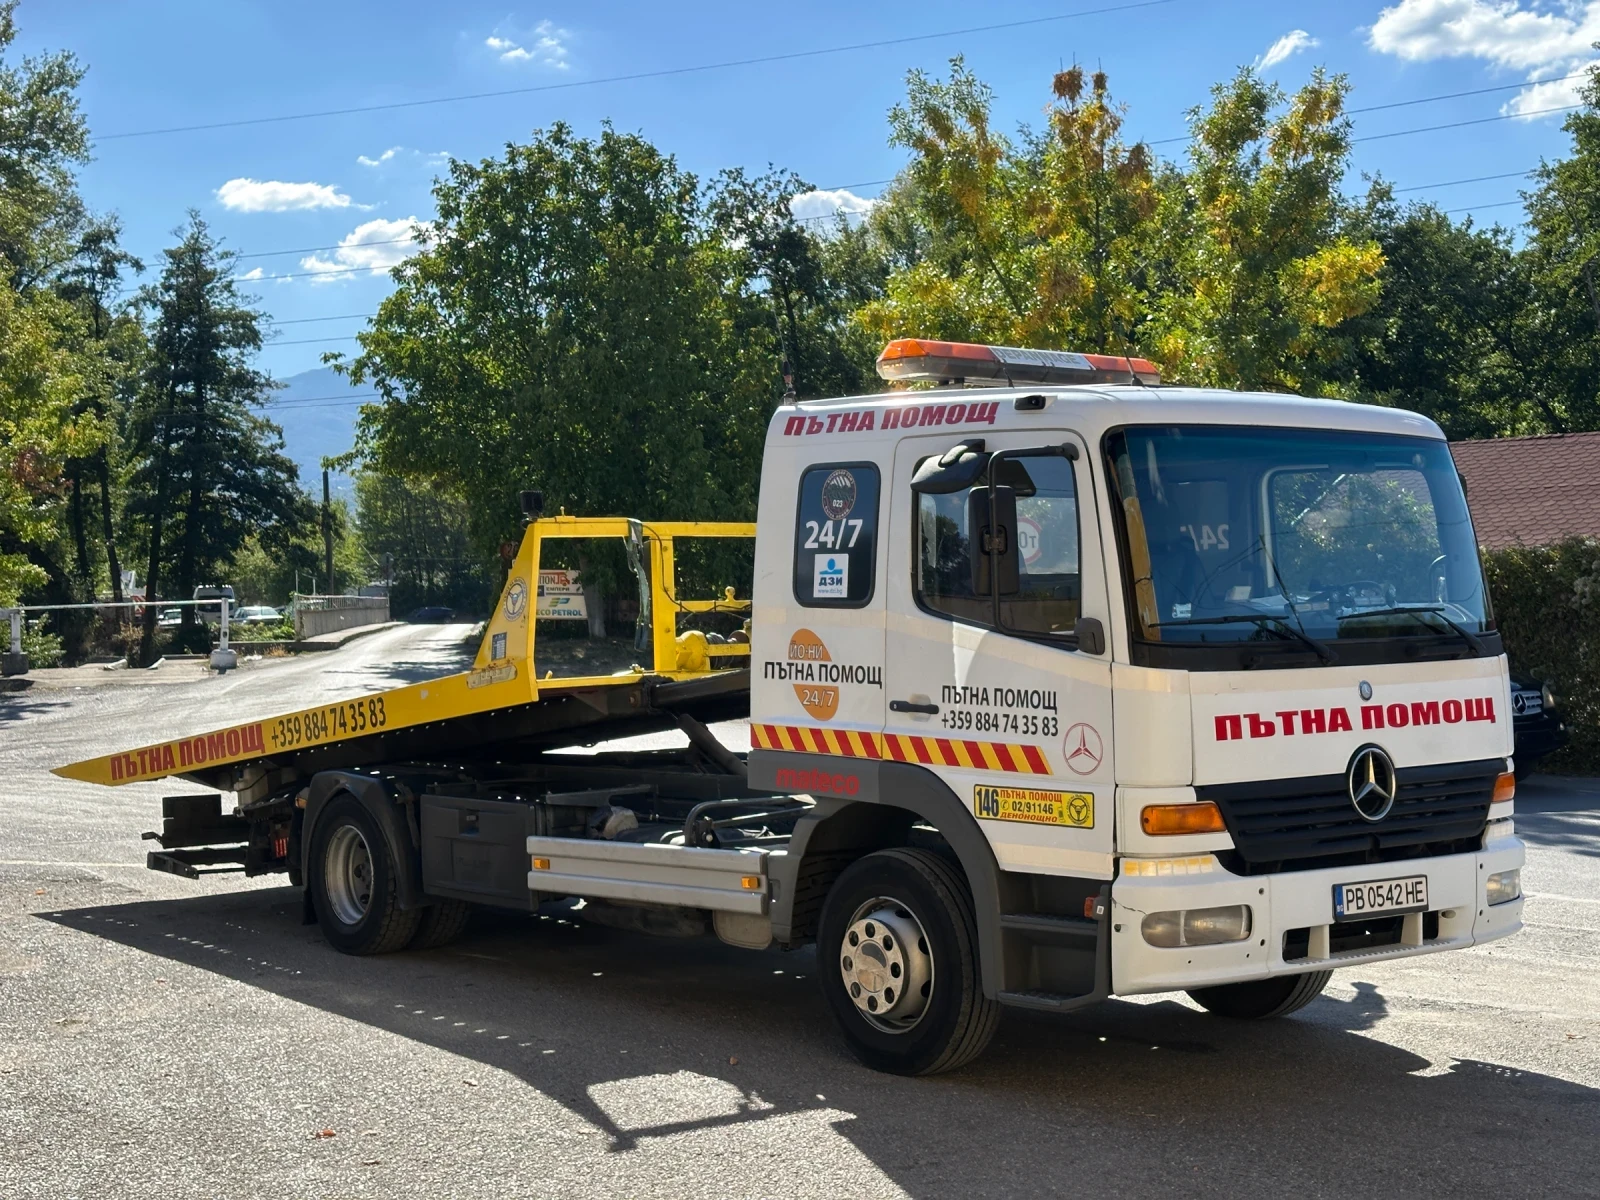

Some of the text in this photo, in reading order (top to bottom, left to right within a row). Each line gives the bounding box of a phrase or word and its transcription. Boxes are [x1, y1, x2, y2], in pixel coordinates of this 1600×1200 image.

[994, 347, 1081, 365] DEPANNAGE
[783, 401, 1000, 436] ПЪТНА ПОМОЩ
[832, 499, 843, 508] 023
[804, 518, 863, 550] 24/7
[818, 576, 843, 587] ДЗИ
[551, 609, 582, 617] PETROL
[764, 661, 882, 690] ПЪТНА ПОМОЩ
[802, 689, 835, 707] 24/7
[941, 685, 1058, 715] ПЪТНА ПОМОЩ
[271, 696, 386, 749] +359 884 74 35 83
[941, 710, 1059, 737] +359 884 74 35 83
[1214, 697, 1497, 741] ПЪТНА ПОМОЩ
[110, 723, 266, 781] ПЪТНА ПОМОЩ
[776, 767, 860, 796] mateco
[1000, 789, 1062, 803] ПЪТНА ПОМОЩ
[976, 788, 999, 817] 146
[1000, 811, 1058, 823] ДЕНОНОЩНО
[1011, 801, 1053, 814] 02/91146
[1345, 888, 1365, 911] PB
[1368, 883, 1403, 908] 0542
[1405, 881, 1424, 904] HE
